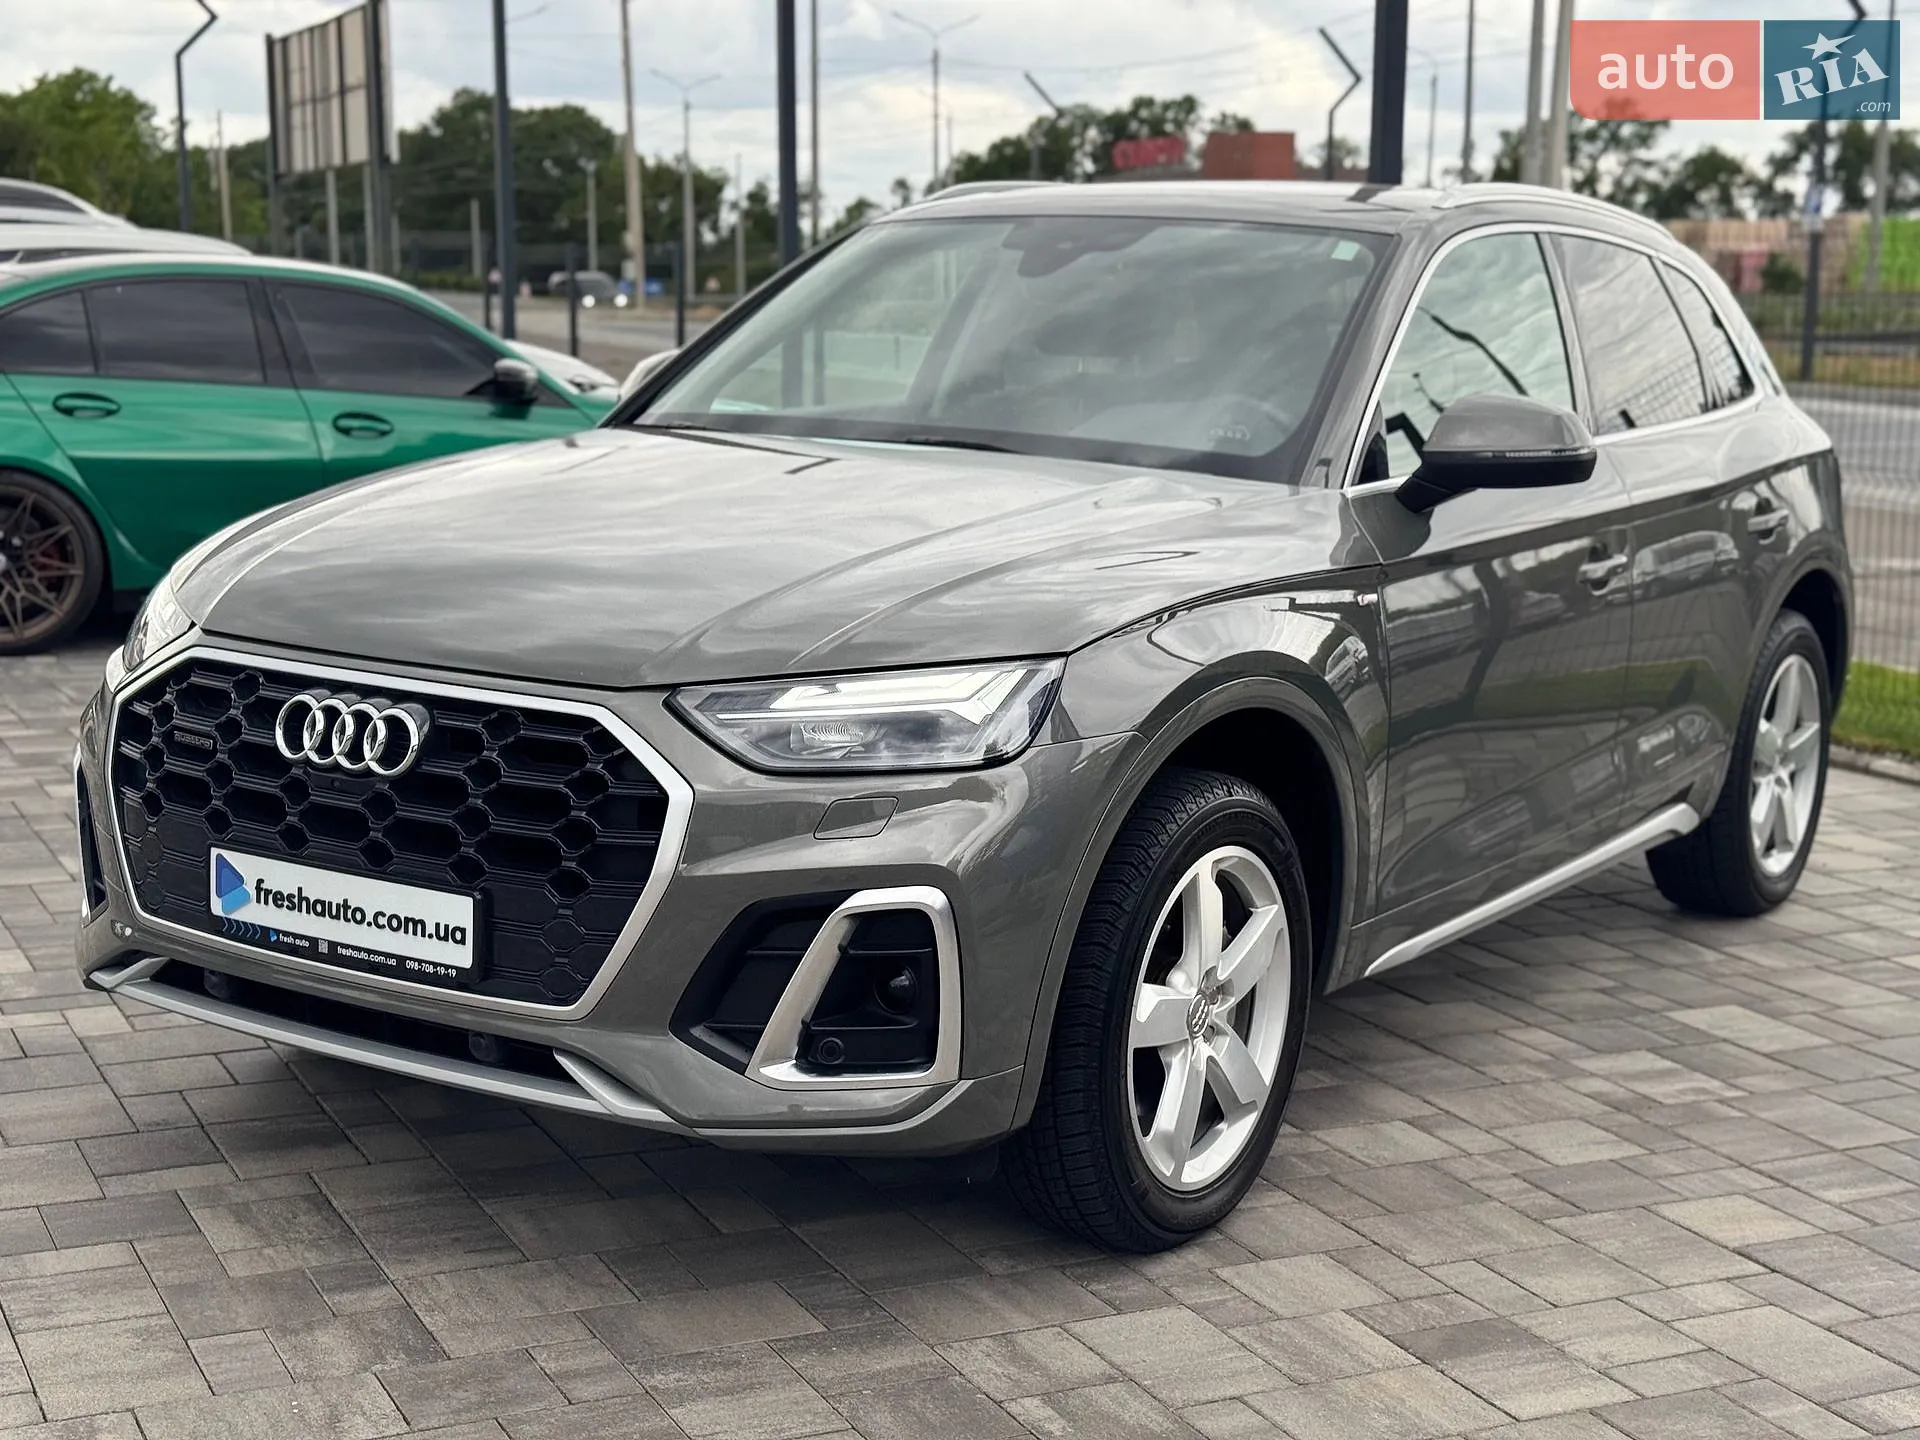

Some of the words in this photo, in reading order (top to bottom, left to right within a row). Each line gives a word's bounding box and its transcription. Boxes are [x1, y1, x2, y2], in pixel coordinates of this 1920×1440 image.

[255, 878, 467, 946] freshauto.com.ua
[279, 933, 295, 944] fresh
[295, 939, 310, 948] auto
[337, 945, 397, 966] freshauto.com.ua
[405, 959, 457, 979] 098-708-19-19
